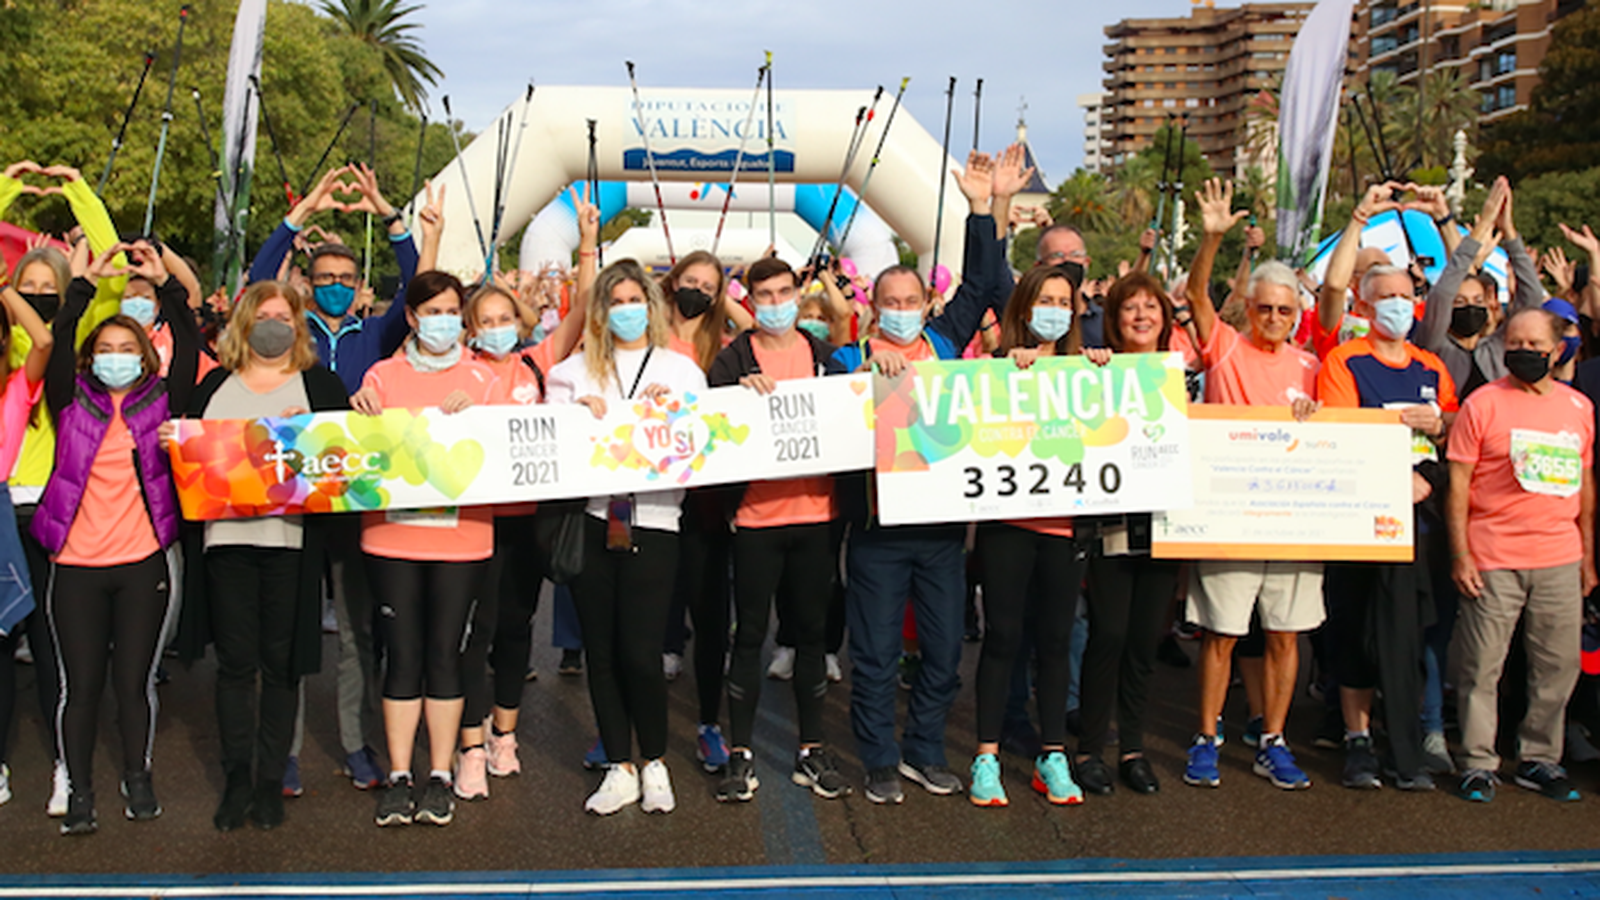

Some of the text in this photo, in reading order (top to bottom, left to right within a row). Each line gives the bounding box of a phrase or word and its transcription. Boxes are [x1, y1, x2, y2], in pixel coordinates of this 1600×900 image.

[768, 391, 816, 421] RUN
[913, 368, 1149, 426] VALENCIA
[508, 417, 557, 443] RUN
[643, 423, 672, 449] YO
[771, 419, 819, 437] CANCER
[978, 425, 1025, 443] CONTRA
[1228, 427, 1292, 442] umivale
[508, 442, 559, 460] CANCER
[774, 434, 820, 463] 2021
[301, 450, 382, 475] aecc
[511, 460, 559, 487] 2021
[962, 461, 1122, 499] 33240
